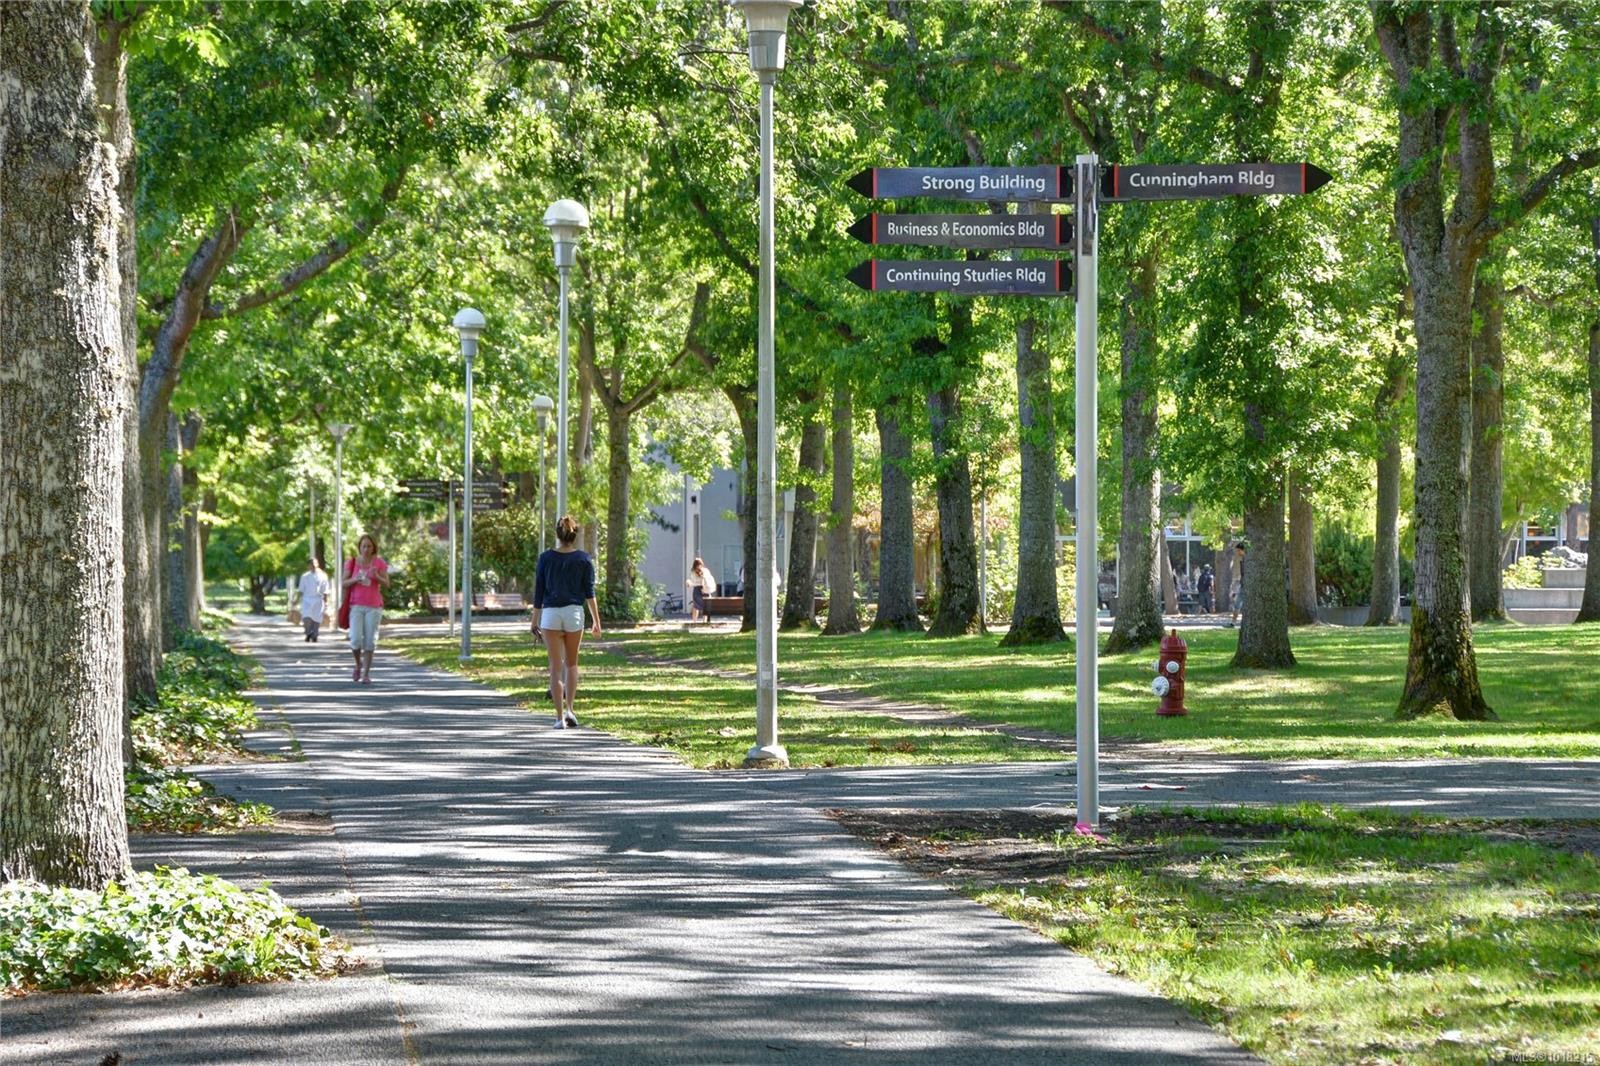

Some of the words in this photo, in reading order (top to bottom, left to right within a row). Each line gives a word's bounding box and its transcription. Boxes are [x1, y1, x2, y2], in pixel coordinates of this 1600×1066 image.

[922, 176, 975, 193] Strong
[980, 175, 1046, 193] Building
[1130, 172, 1234, 189] Cunningham
[1239, 171, 1275, 189] Bldg
[888, 222, 938, 236] Business
[941, 222, 950, 236] &
[953, 222, 1015, 236] Economics
[1018, 221, 1045, 238] Bldg
[886, 268, 961, 286] Continuing
[964, 268, 1013, 282] Studies
[1016, 267, 1046, 284] Bldg
